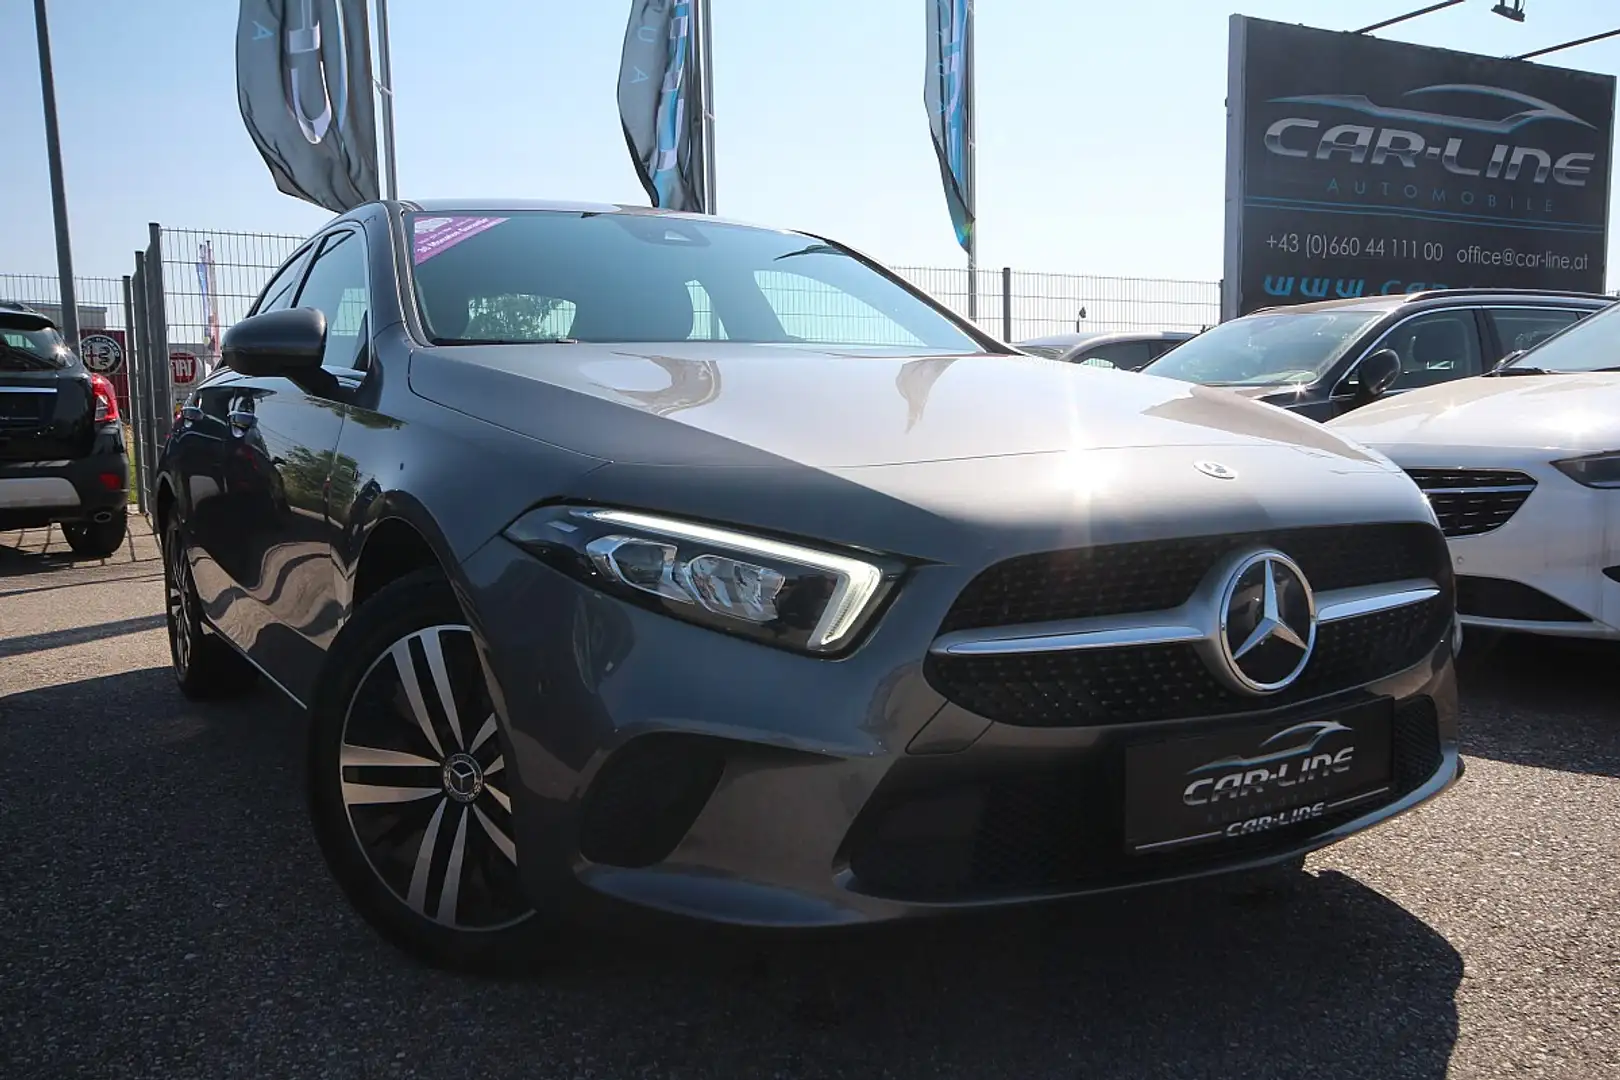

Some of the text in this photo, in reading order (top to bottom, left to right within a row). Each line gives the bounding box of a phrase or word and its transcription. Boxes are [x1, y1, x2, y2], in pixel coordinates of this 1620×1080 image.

[1263, 117, 1595, 186] CAR-LINE
[1326, 177, 1554, 213] AUTOMOBILE
[1266, 233, 1299, 253] +43
[1365, 238, 1385, 257] 44
[1392, 239, 1417, 259] 111
[1424, 242, 1443, 261] 00
[1456, 245, 1589, 270] office@car-line.at
[1183, 746, 1354, 805] CAR-LINE
[1226, 802, 1325, 838] CAR-LINE
